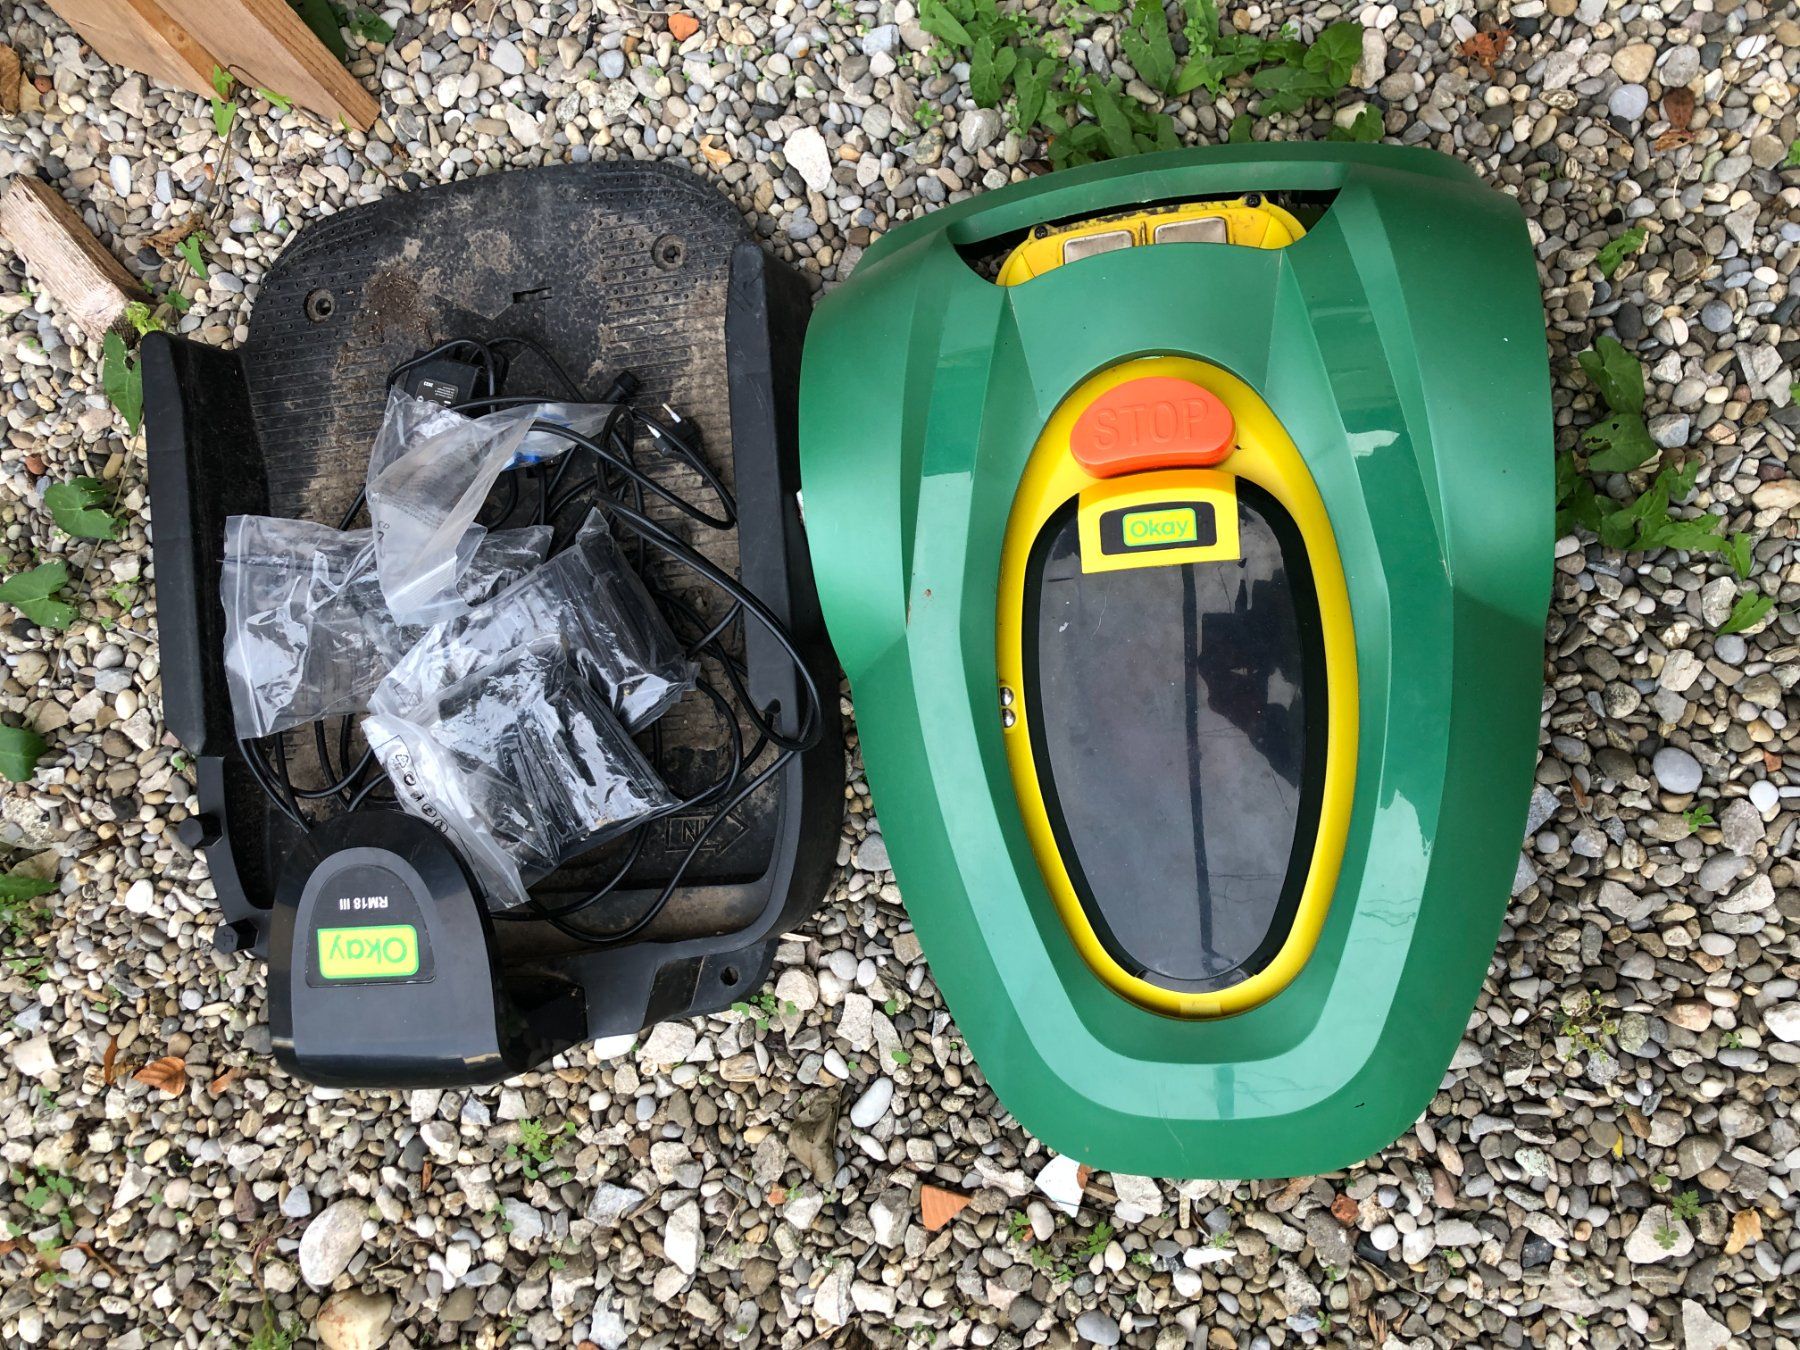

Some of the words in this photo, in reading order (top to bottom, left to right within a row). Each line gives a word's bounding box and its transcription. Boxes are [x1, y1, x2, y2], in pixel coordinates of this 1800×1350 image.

[1094, 398, 1208, 449] STOP
[1130, 518, 1191, 537] Okay
[339, 897, 351, 911] III
[352, 895, 389, 909] RM18
[327, 935, 408, 964] Okay
